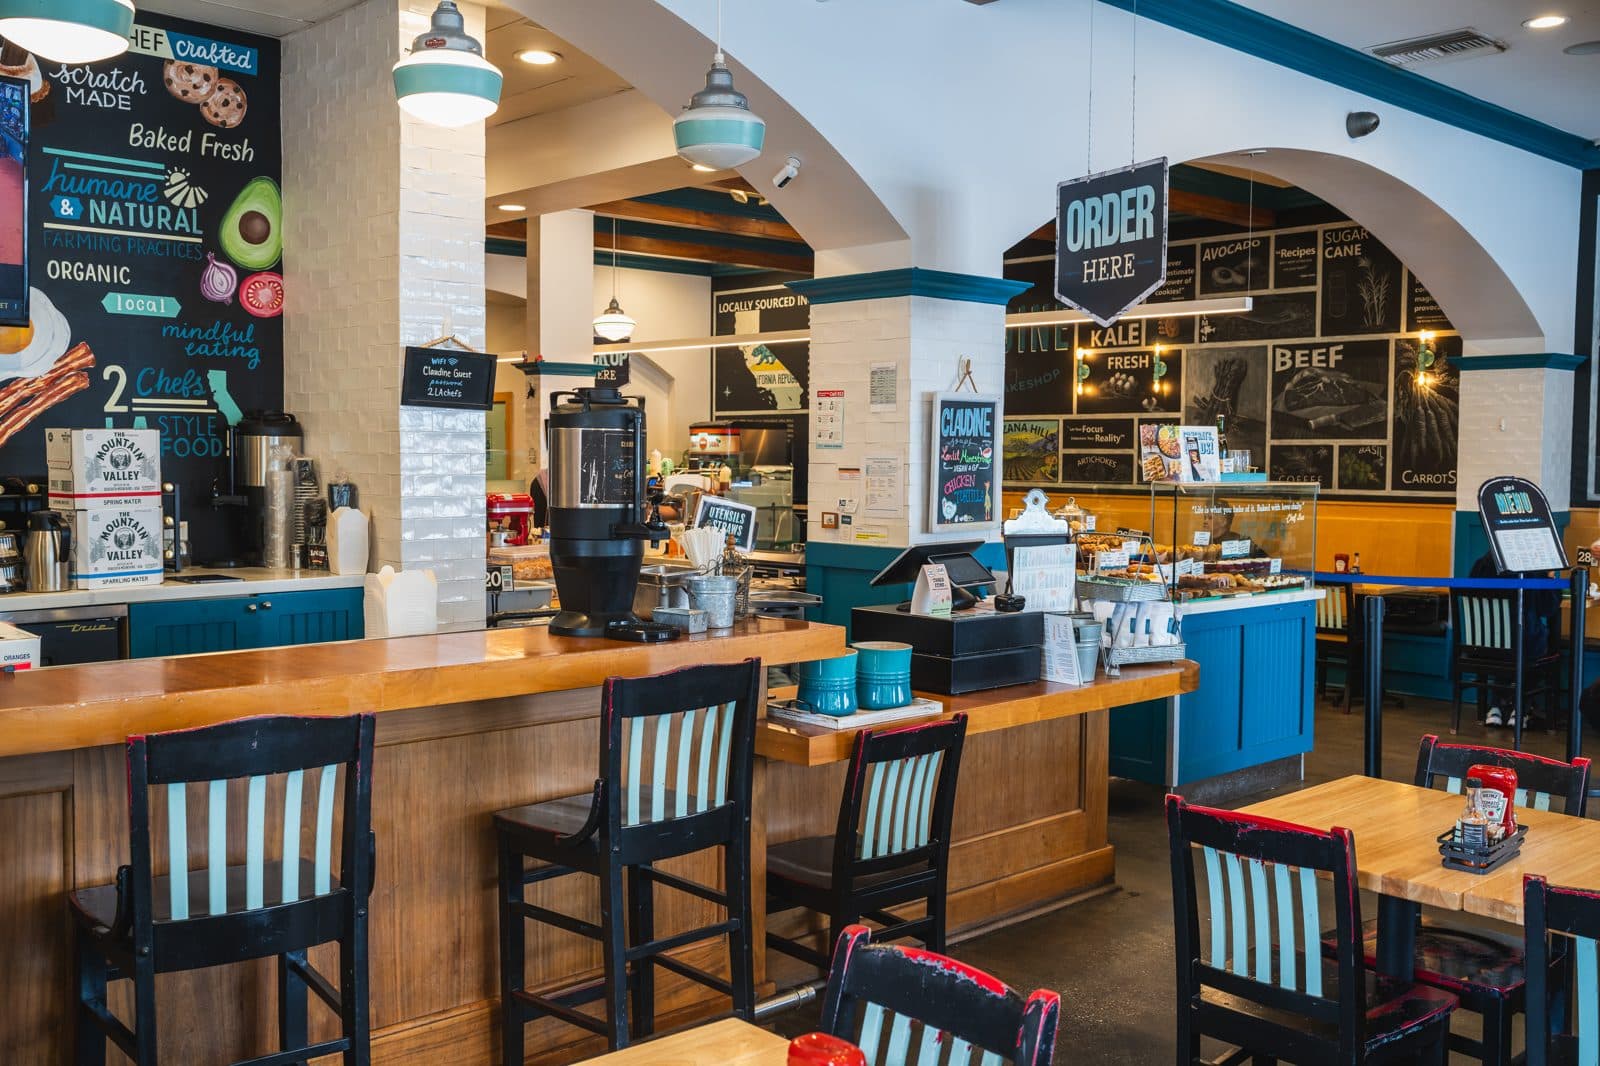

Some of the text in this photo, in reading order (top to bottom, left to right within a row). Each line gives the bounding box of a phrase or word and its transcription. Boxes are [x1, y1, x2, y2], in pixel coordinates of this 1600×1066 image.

[130, 29, 252, 69] HEF crafted
[49, 64, 148, 95] scratch
[66, 87, 131, 111] MADE
[129, 123, 254, 162] Baked Fresh
[41, 157, 159, 202] humane
[59, 198, 203, 234] & NATURAL
[1066, 185, 1156, 253] ORDER
[43, 231, 203, 260] FARMING PRACTICES
[1325, 229, 1369, 244] SUGAR
[1202, 240, 1261, 262] AVOCADO
[1325, 244, 1362, 259] CANE
[47, 260, 131, 284] ORGANIC
[1082, 253, 1135, 283] HERE
[116, 293, 166, 313] local
[719, 300, 753, 314] LOCALLY
[755, 297, 794, 310] SOURCED
[162, 321, 254, 343] mindful
[1090, 323, 1139, 347] KALE
[185, 342, 261, 370] eating
[1107, 355, 1149, 370] FRESH
[1275, 345, 1344, 372] BEEF
[423, 366, 472, 378] Claudine Guest
[598, 370, 616, 380] ERE
[103, 365, 206, 412] 2 Chefs
[158, 416, 217, 437] STYLE
[941, 407, 992, 437] CLAUDINE
[1082, 425, 1104, 433] Focus
[96, 438, 145, 461] MOUNTAIN
[1077, 456, 1117, 469] ARTICHOKES
[103, 470, 140, 481] VALLEY
[944, 474, 976, 495] CHICKEN
[1494, 492, 1533, 514] MENU
[709, 506, 746, 524] UTENSILS
[101, 517, 148, 541] MOUNTAIN
[107, 550, 143, 561] VALLEY
[1578, 551, 1591, 563] 28
[3, 653, 31, 661] ORANGES
